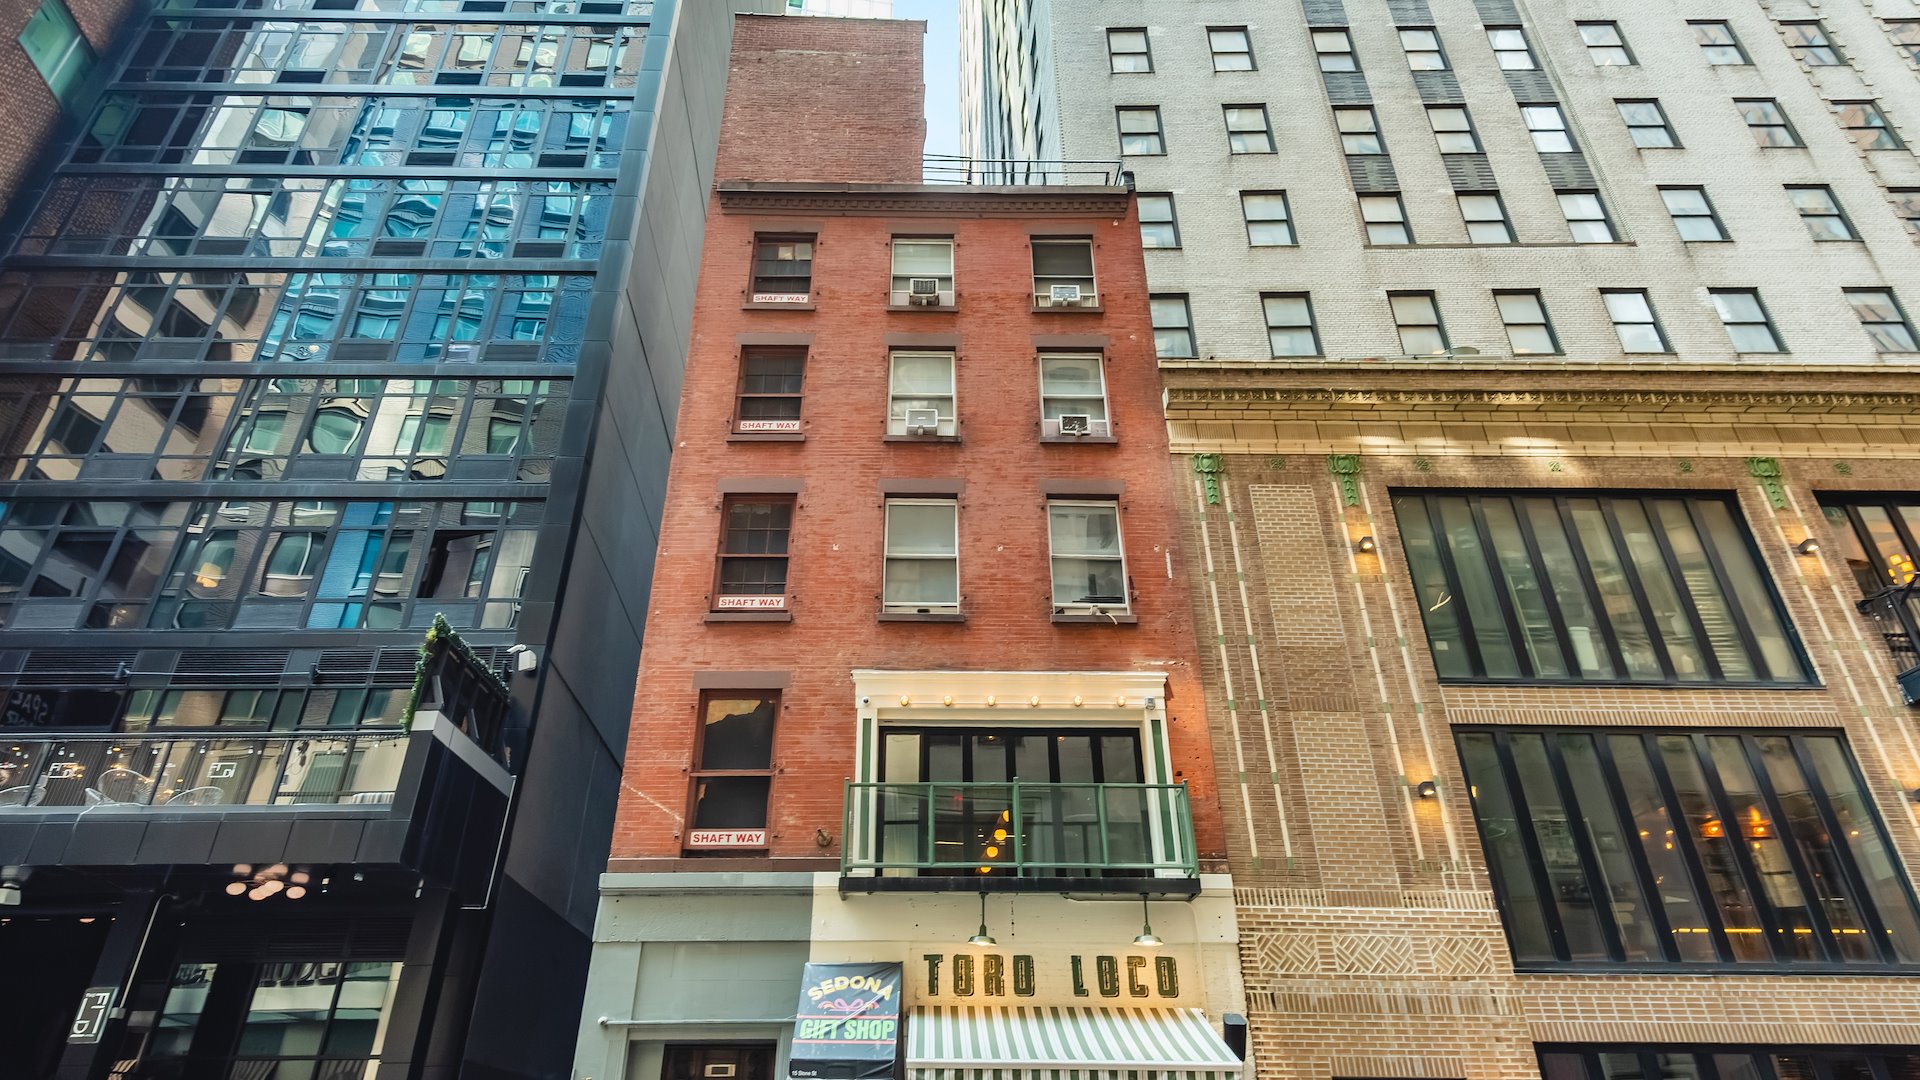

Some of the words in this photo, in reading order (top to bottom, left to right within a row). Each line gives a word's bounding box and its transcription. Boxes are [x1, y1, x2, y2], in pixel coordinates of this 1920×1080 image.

[693, 834, 732, 842] SHAFT
[736, 834, 761, 842] WAY
[923, 954, 1035, 997] TORO
[1070, 954, 1179, 997] LOCO
[808, 975, 893, 1001] SEDONA
[800, 1018, 839, 1039] GIFT
[844, 1018, 895, 1040] SHOP
